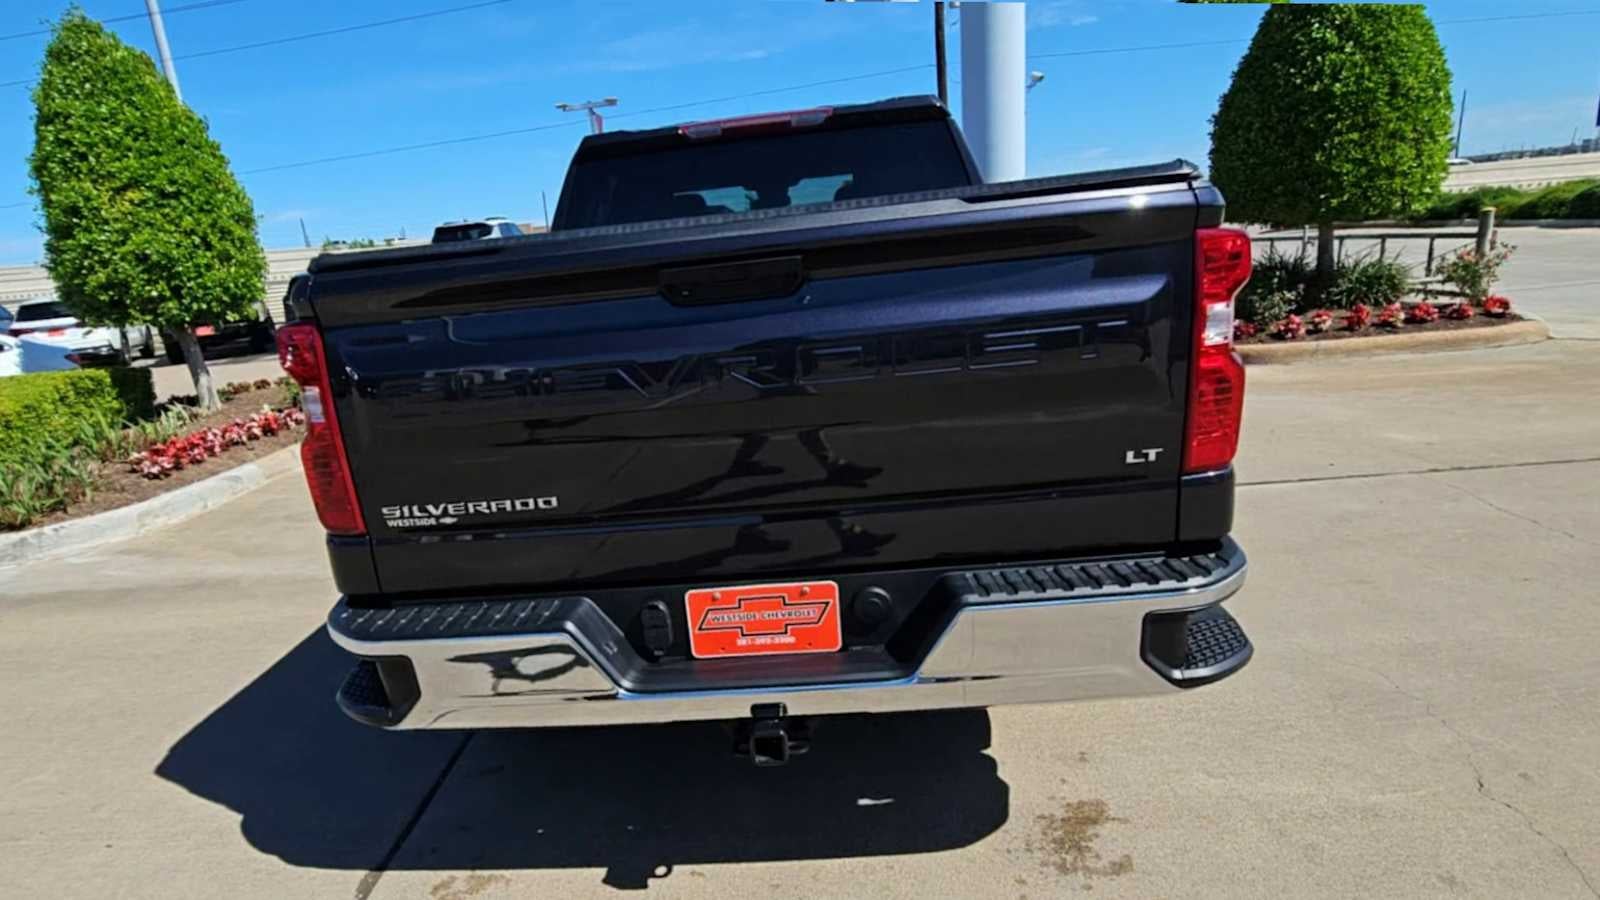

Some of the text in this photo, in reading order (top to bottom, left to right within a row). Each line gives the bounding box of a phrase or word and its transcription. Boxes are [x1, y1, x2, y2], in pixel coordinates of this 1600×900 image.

[1125, 447, 1164, 464] LT
[381, 496, 559, 519] SILVERADO
[386, 516, 438, 528] WESTSIDE
[711, 609, 817, 623] WESTSIDE CHEVROLET
